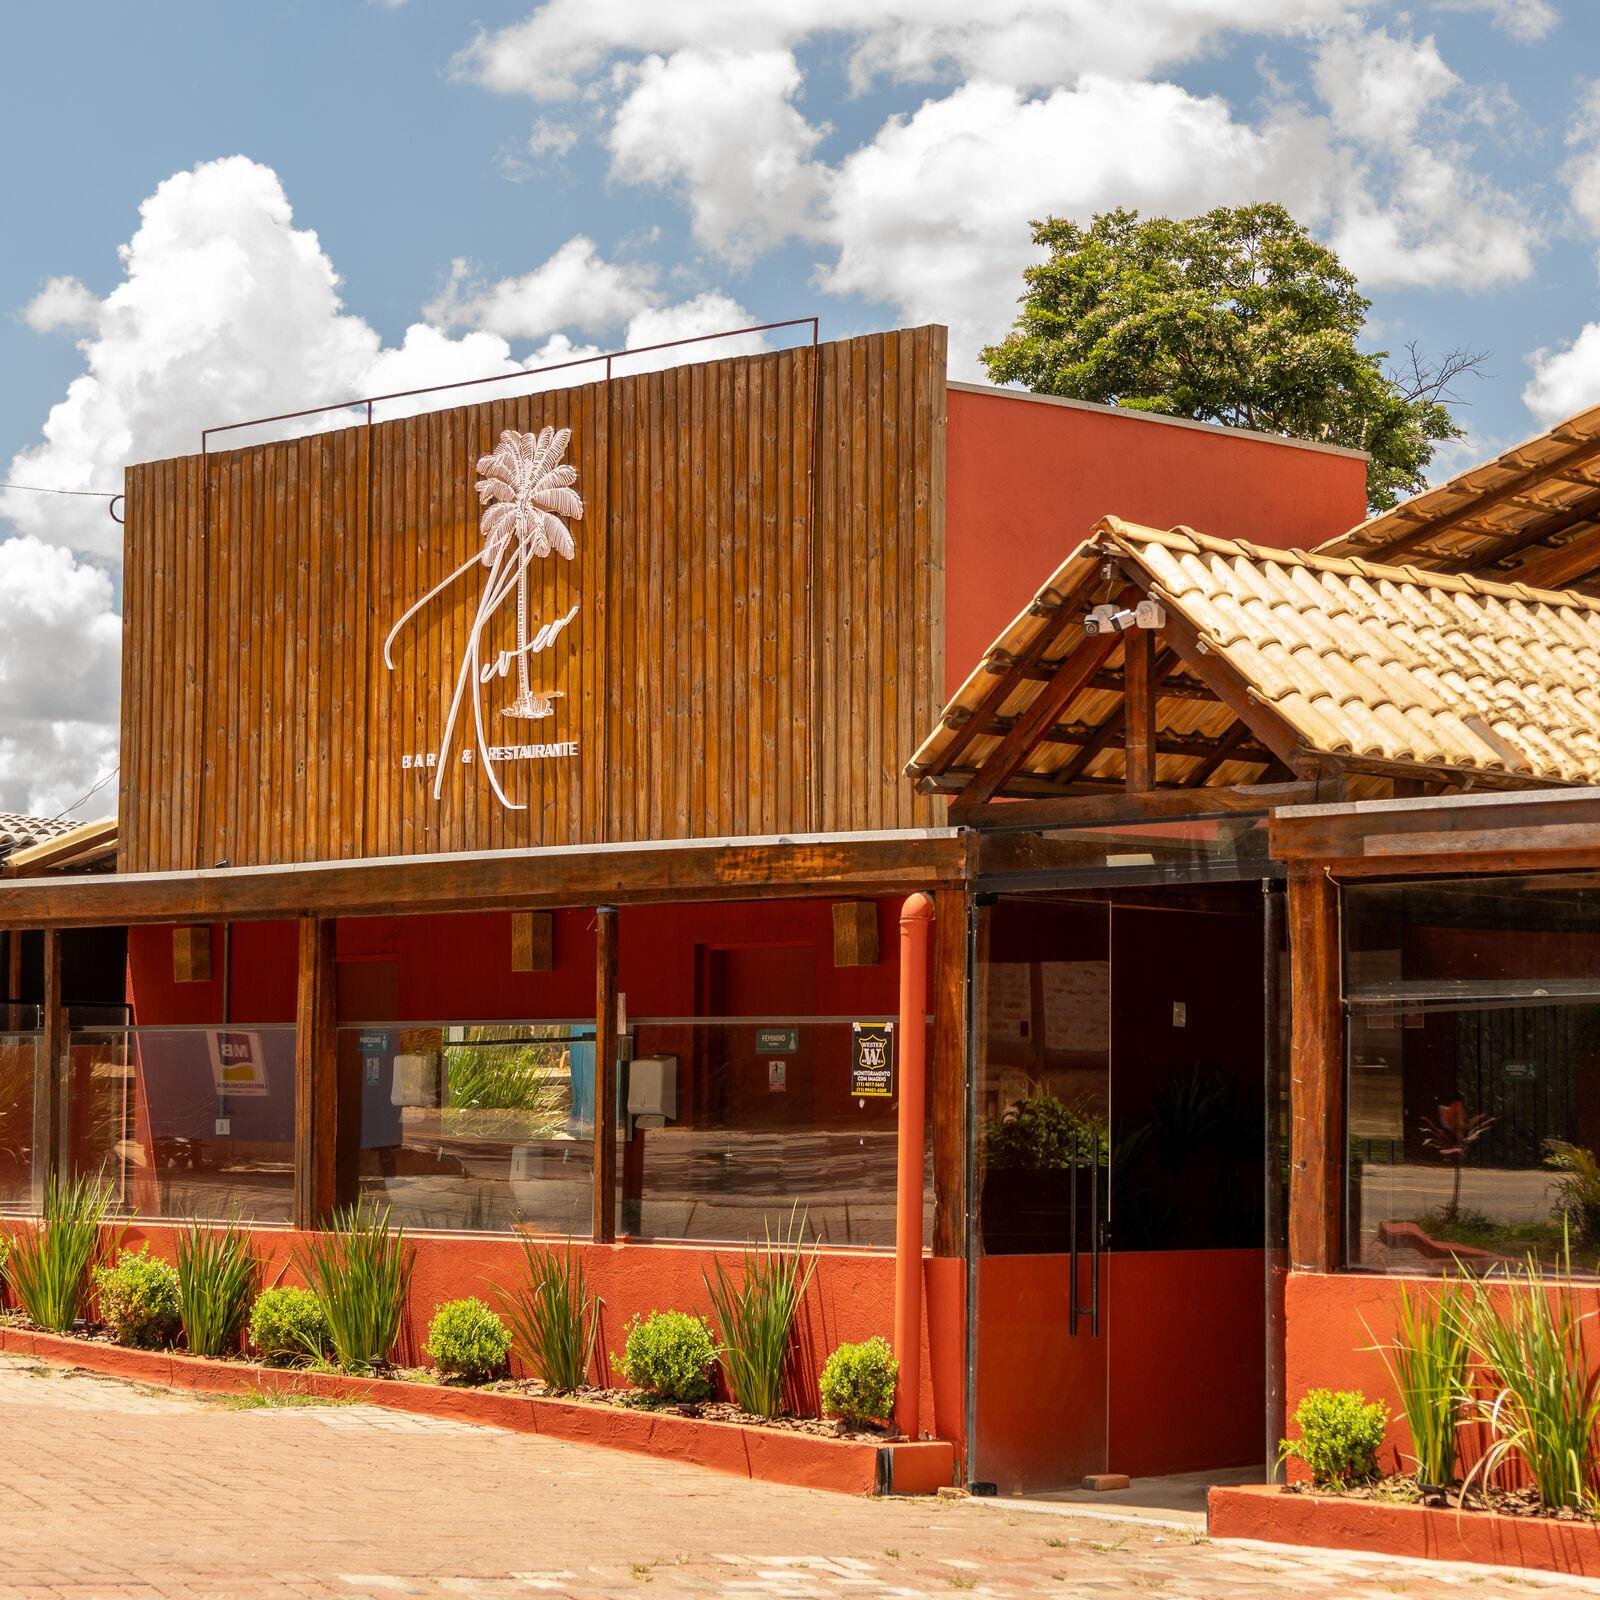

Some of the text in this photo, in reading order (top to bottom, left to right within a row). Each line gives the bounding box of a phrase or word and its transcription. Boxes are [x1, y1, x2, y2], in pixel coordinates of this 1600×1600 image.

[402, 742, 579, 768] BAR & RESTAURANTE
[761, 1034, 786, 1042] FEMININO
[863, 1048, 881, 1065] W
[853, 1070, 891, 1078] MONITORAMENTO
